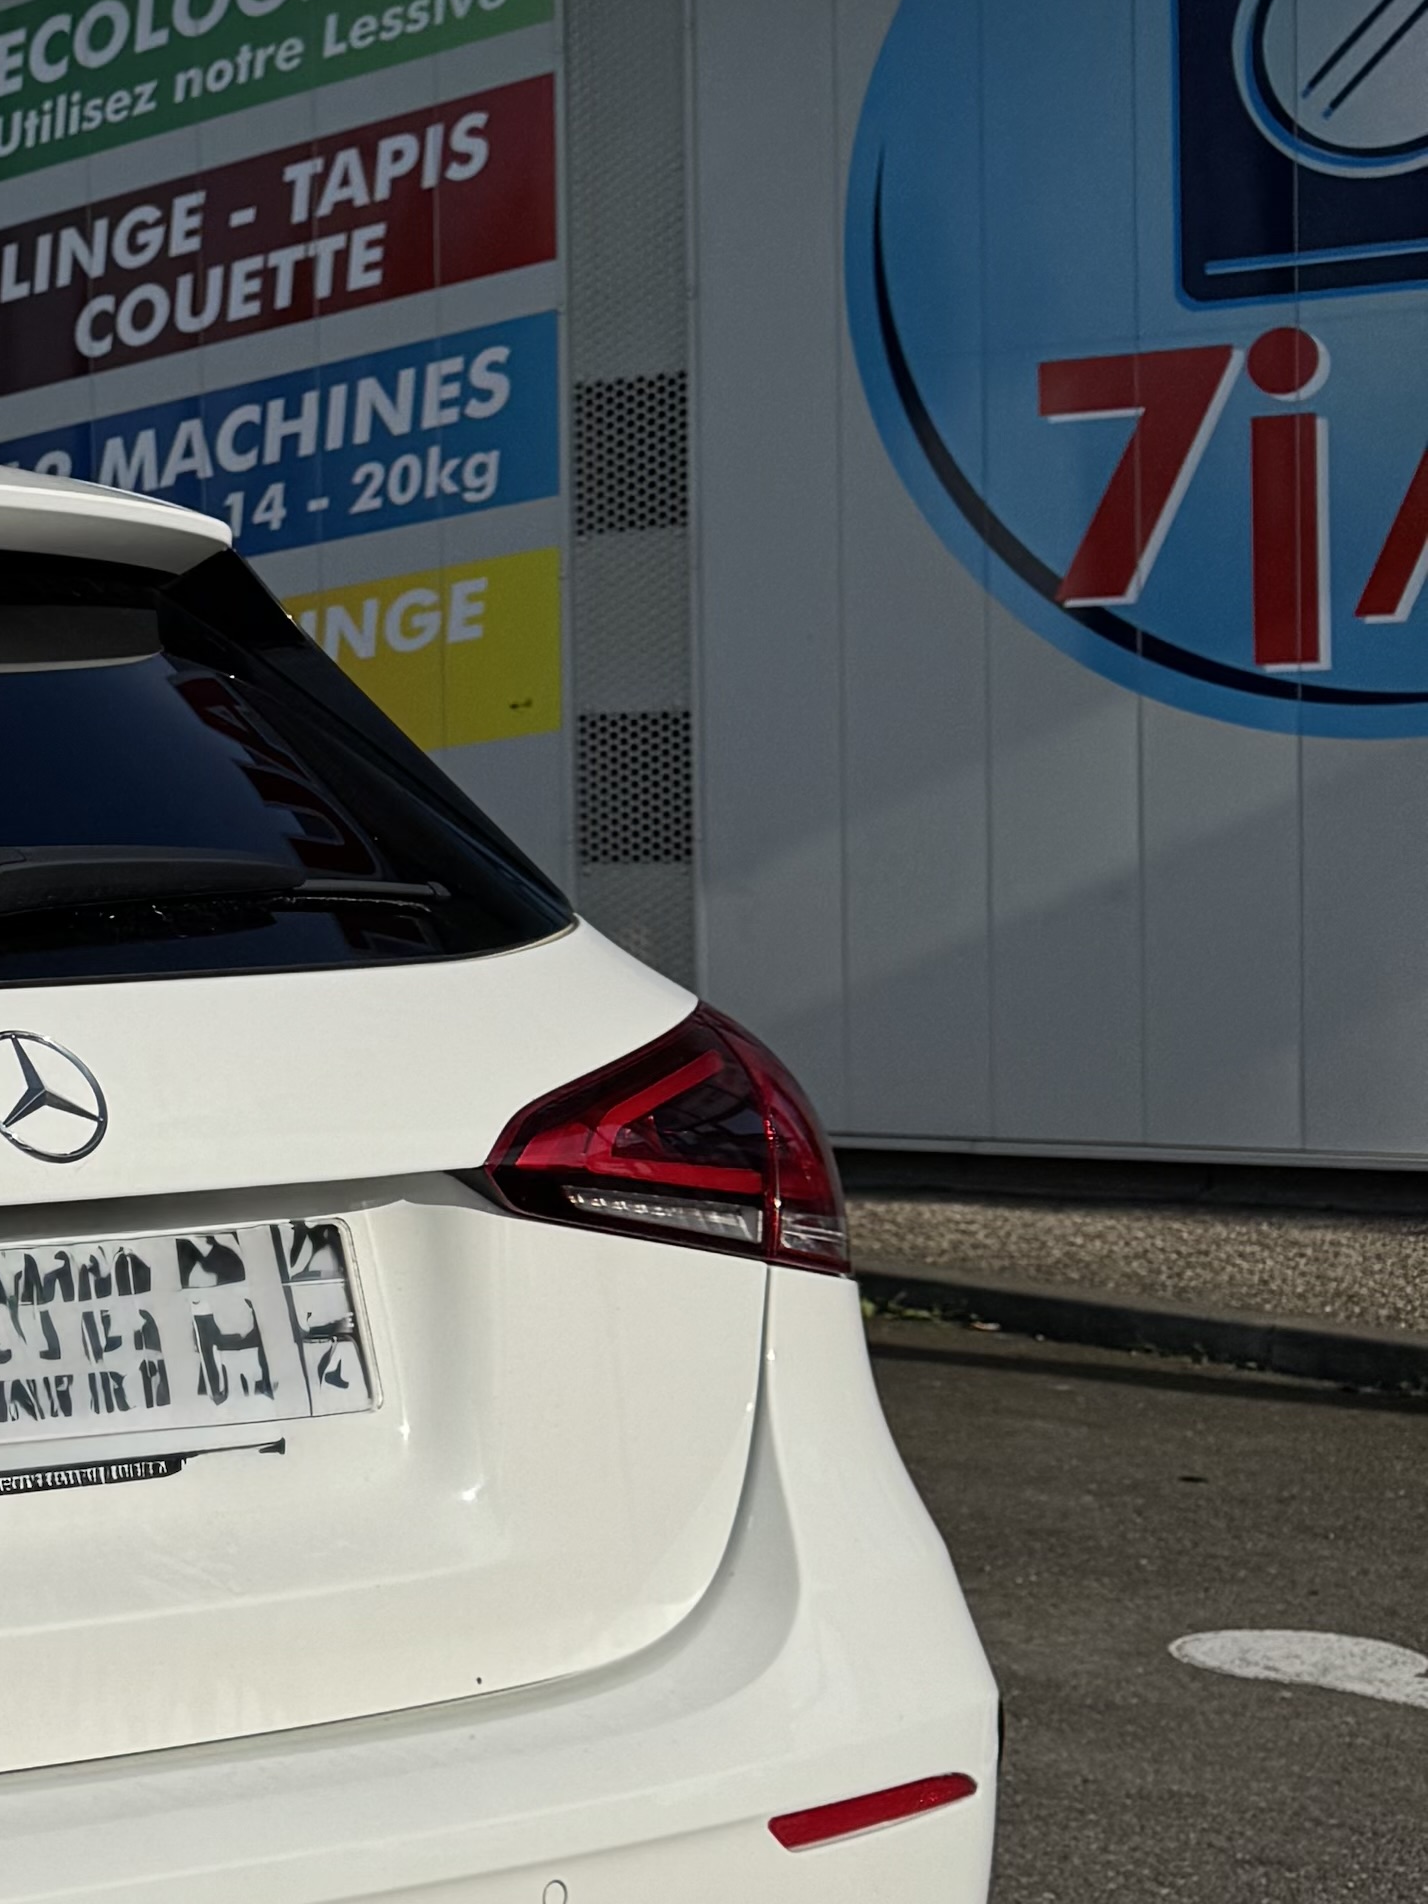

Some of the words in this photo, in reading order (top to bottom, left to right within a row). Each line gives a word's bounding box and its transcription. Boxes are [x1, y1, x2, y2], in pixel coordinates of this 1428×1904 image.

[172, 35, 304, 104] notre
[0, 190, 207, 303] LINGE
[283, 111, 491, 224] TAPIS
[73, 223, 387, 358] COUETTE
[98, 346, 512, 494] MACHINES
[351, 446, 500, 516] 20kg
